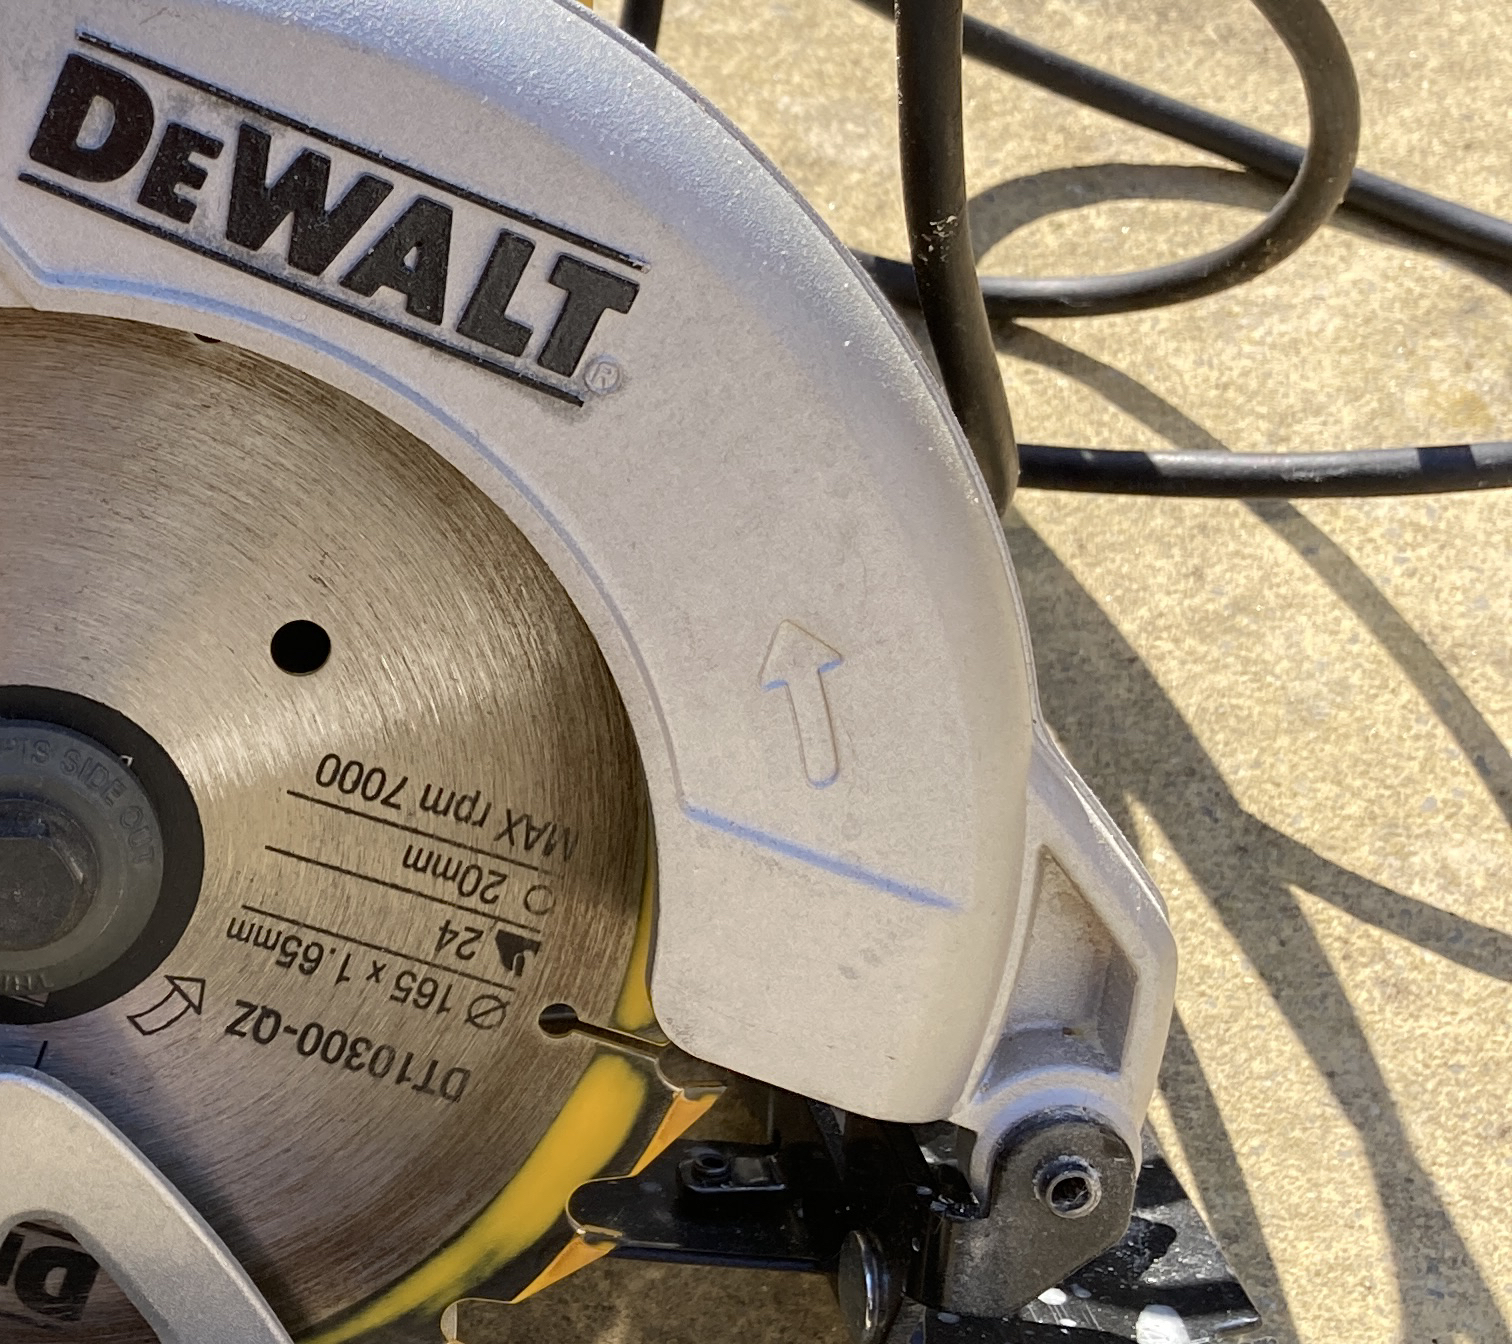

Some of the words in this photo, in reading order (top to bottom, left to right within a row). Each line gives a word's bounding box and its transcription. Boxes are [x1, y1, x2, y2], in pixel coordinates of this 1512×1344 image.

[30, 53, 640, 378] DEWALT
[59, 748, 128, 807] SIDE
[118, 804, 156, 865] OUT
[315, 753, 409, 811] 7000
[419, 783, 493, 829] rpm
[494, 809, 579, 862] MAX
[402, 844, 508, 905] 20mm
[226, 917, 352, 987] 1.65mm
[435, 919, 485, 960] 24
[366, 959, 383, 985] x
[389, 978, 453, 1017] 165
[224, 999, 473, 1104] DT10300-QZ
